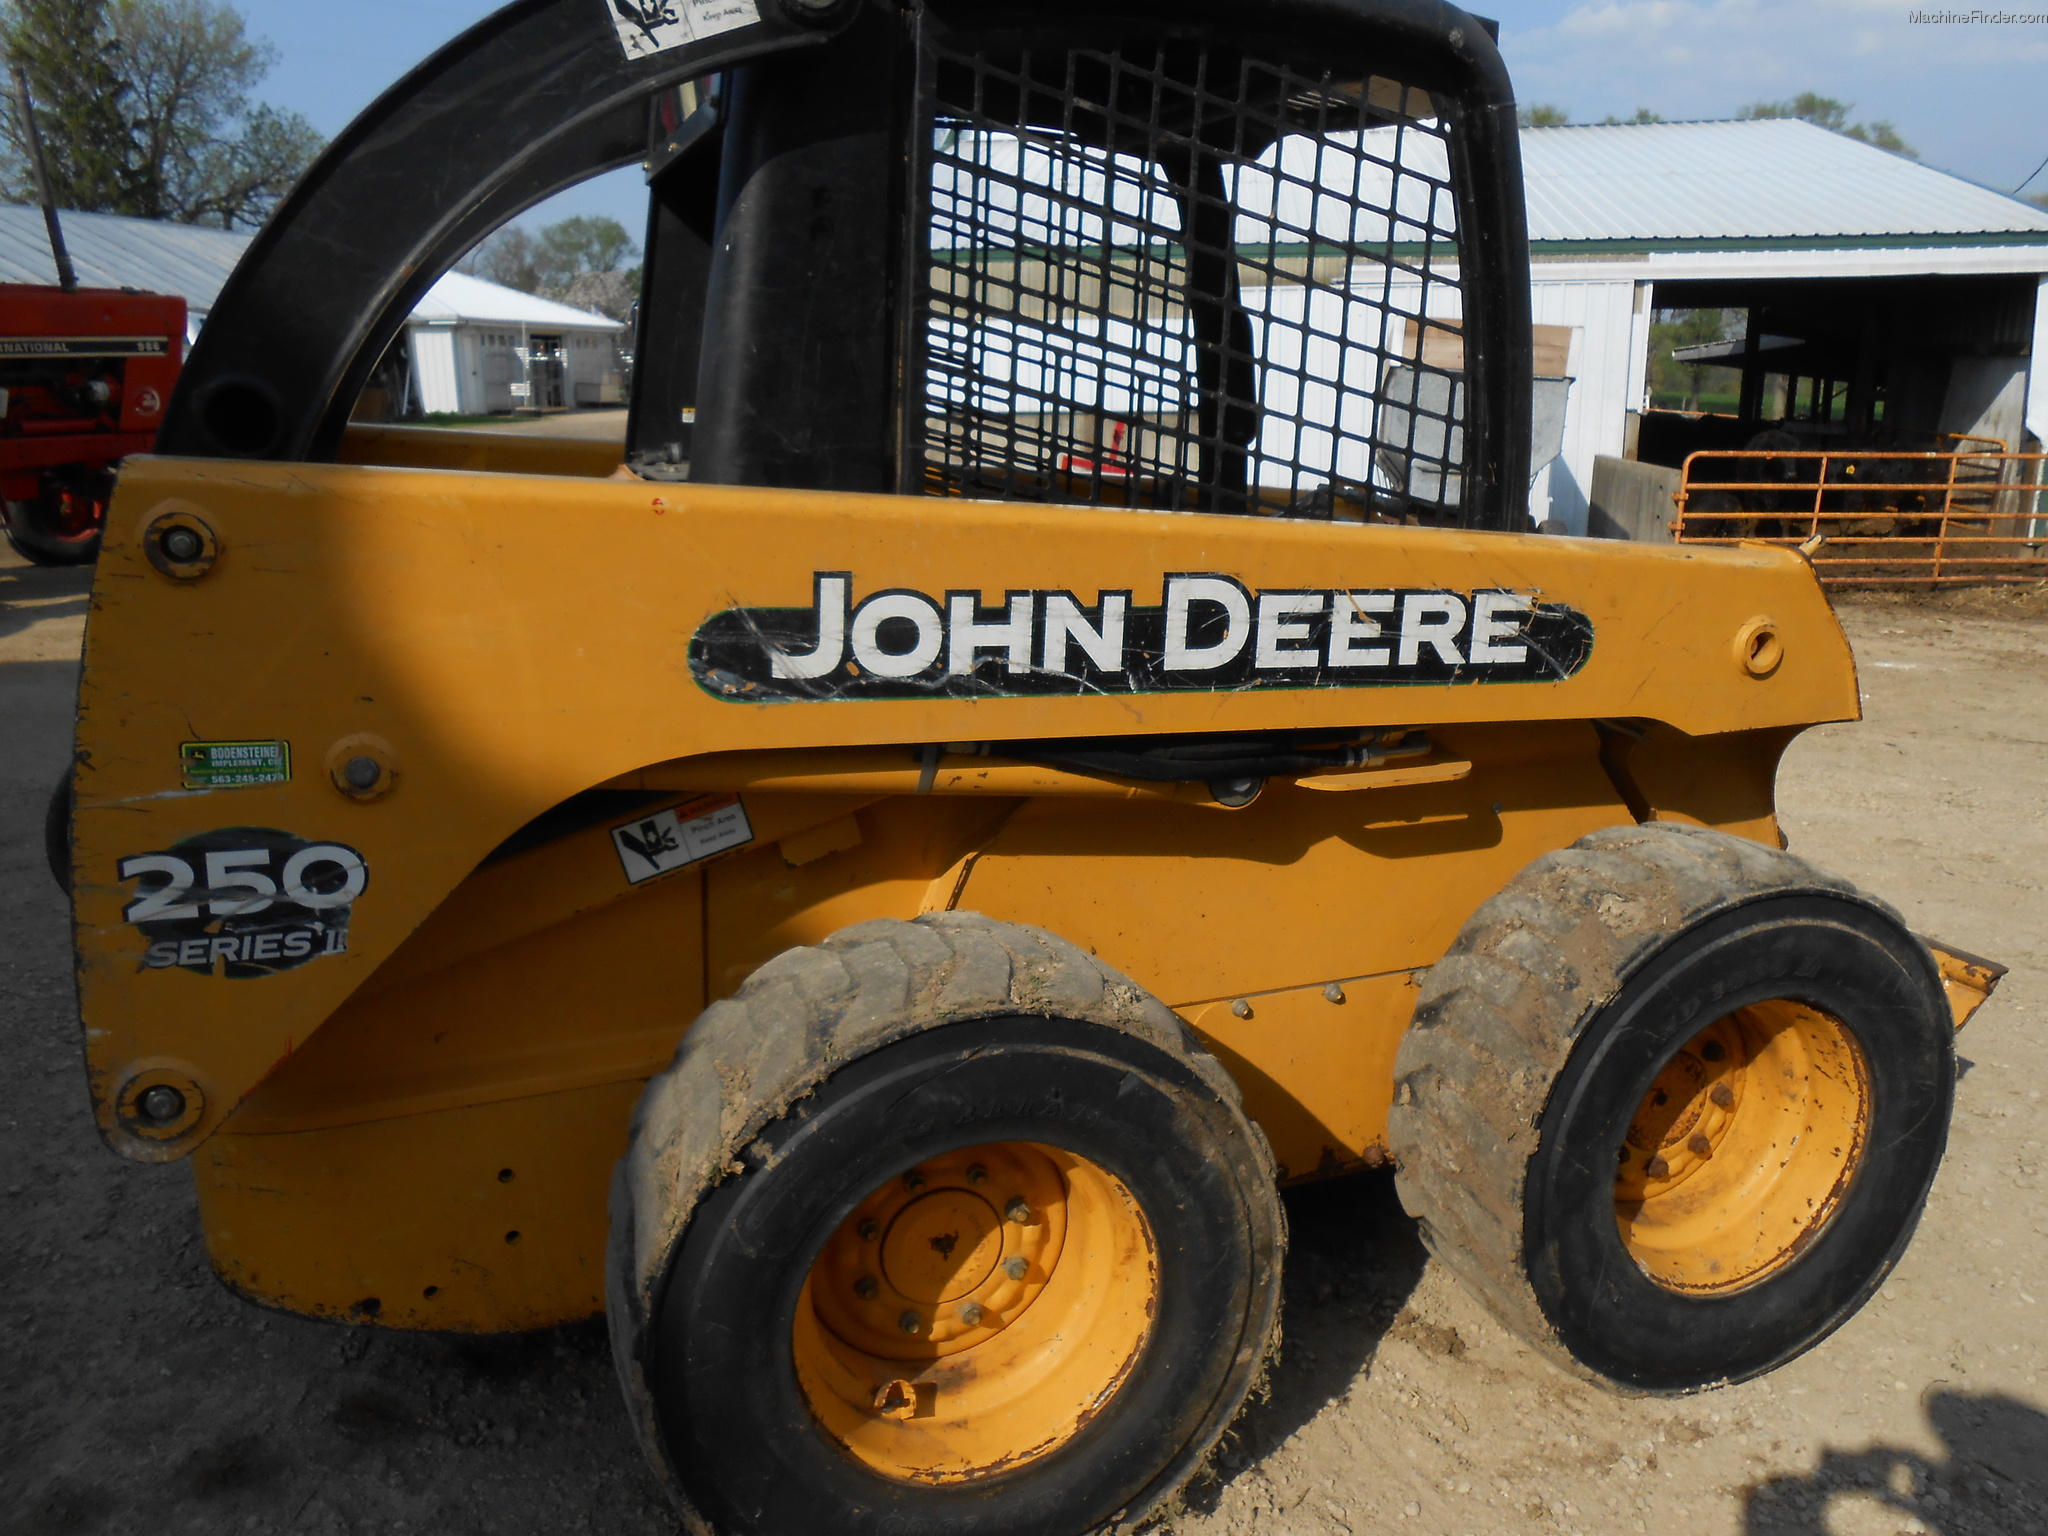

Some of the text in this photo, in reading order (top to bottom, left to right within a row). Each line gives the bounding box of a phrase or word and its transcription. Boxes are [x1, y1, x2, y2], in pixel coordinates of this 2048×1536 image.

[771, 577, 1534, 681] JOHN DEERE
[211, 747, 281, 759] BODENSTEINE
[691, 813, 736, 834] Pinch Area
[121, 843, 368, 923] 250
[146, 931, 312, 968] SERIES
